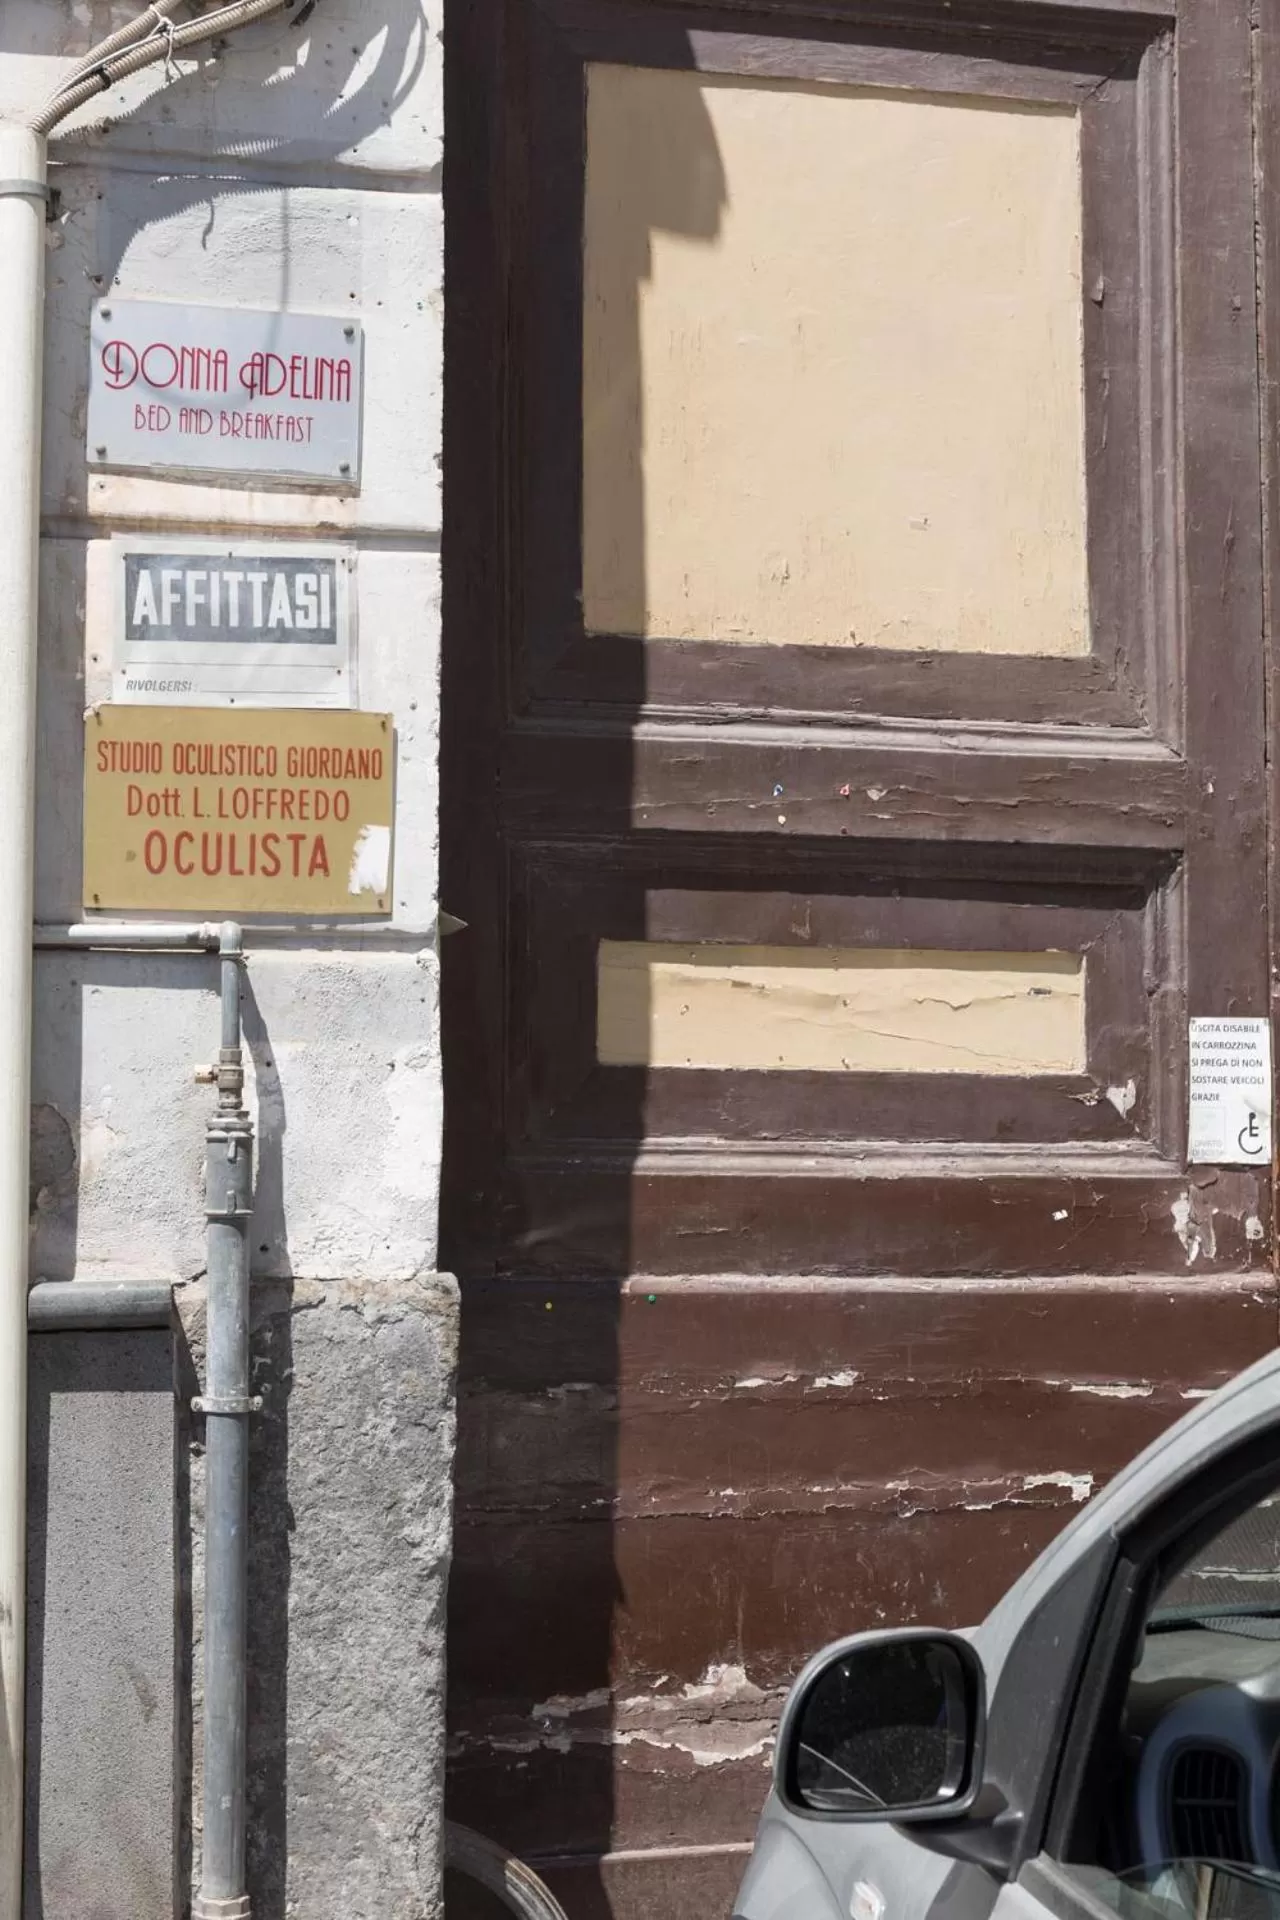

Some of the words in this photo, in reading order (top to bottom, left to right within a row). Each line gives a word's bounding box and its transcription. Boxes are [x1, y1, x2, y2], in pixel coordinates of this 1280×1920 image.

[102, 340, 228, 393] DONNA
[239, 352, 352, 402] ADELINA
[135, 404, 171, 431] BED
[179, 407, 214, 435] AND
[219, 410, 314, 443] BREAKFAST
[132, 569, 331, 629] AFFITTASI
[97, 740, 163, 774] STUDIO
[172, 742, 277, 778] OCULISTICO
[287, 746, 383, 781] GIORDANO
[127, 784, 186, 818] Dott.
[193, 787, 211, 818] L.
[217, 787, 351, 822] LOFFREDO
[144, 830, 330, 878] OCULISTA
[1200, 1059, 1229, 1067] PREGA
[1242, 1059, 1263, 1067] NON
